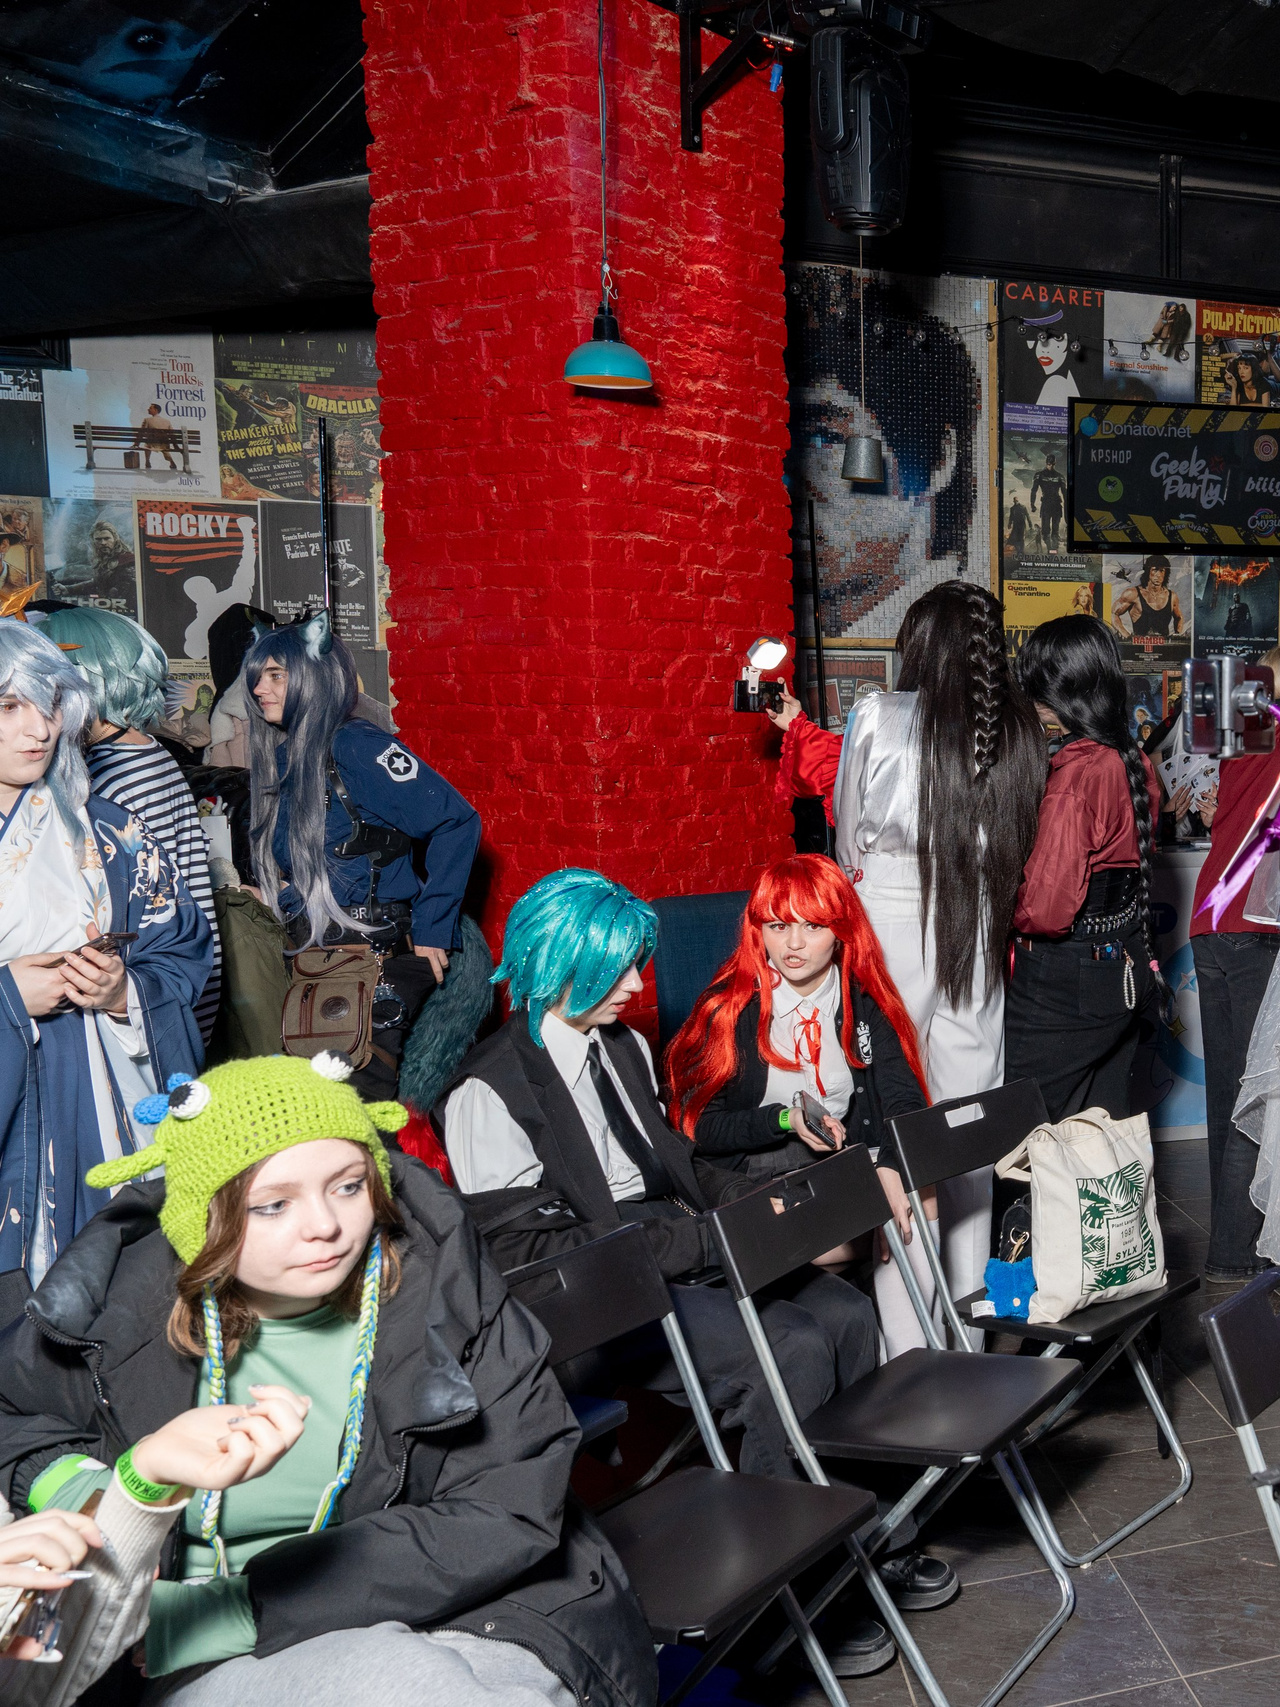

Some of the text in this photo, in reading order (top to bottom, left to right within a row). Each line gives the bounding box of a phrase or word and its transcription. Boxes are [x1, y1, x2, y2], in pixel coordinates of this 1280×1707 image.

[1005, 282, 1104, 308] CABARET
[1202, 308, 1234, 332] PULP
[168, 358, 194, 372] Tom
[1109, 360, 1169, 372] Eternal Sunshine
[0, 370, 14, 385] he
[160, 370, 204, 387] Hanks is
[155, 383, 206, 402] Forrest
[164, 402, 206, 423] Gump
[306, 394, 377, 415] DRACULA
[219, 422, 298, 443] FRANKENSTEIN
[1101, 419, 1192, 438] Donatov.net
[225, 440, 303, 461] THE WOLF MAN
[1090, 448, 1132, 464] KPSHOP
[271, 461, 301, 471] KNOWLES
[1150, 445, 1207, 480] Geek
[178, 476, 201, 487] July 6
[268, 480, 306, 491] LON CHANEY
[1162, 467, 1225, 510] Party
[145, 511, 231, 539] ROCKY
[1188, 523, 1210, 534] Чудес
[1247, 514, 1280, 530] Смузи
[282, 530, 322, 542] Francis Ford Coppol
[287, 549, 310, 560] Padrino
[1012, 553, 1093, 563] CAPTAIN AMERICA
[61, 596, 129, 609] THOR
[1132, 635, 1166, 646] RAMBO
[1143, 645, 1154, 653] III
[381, 746, 398, 764] POLICE
[1115, 1245, 1138, 1261] SYLX
